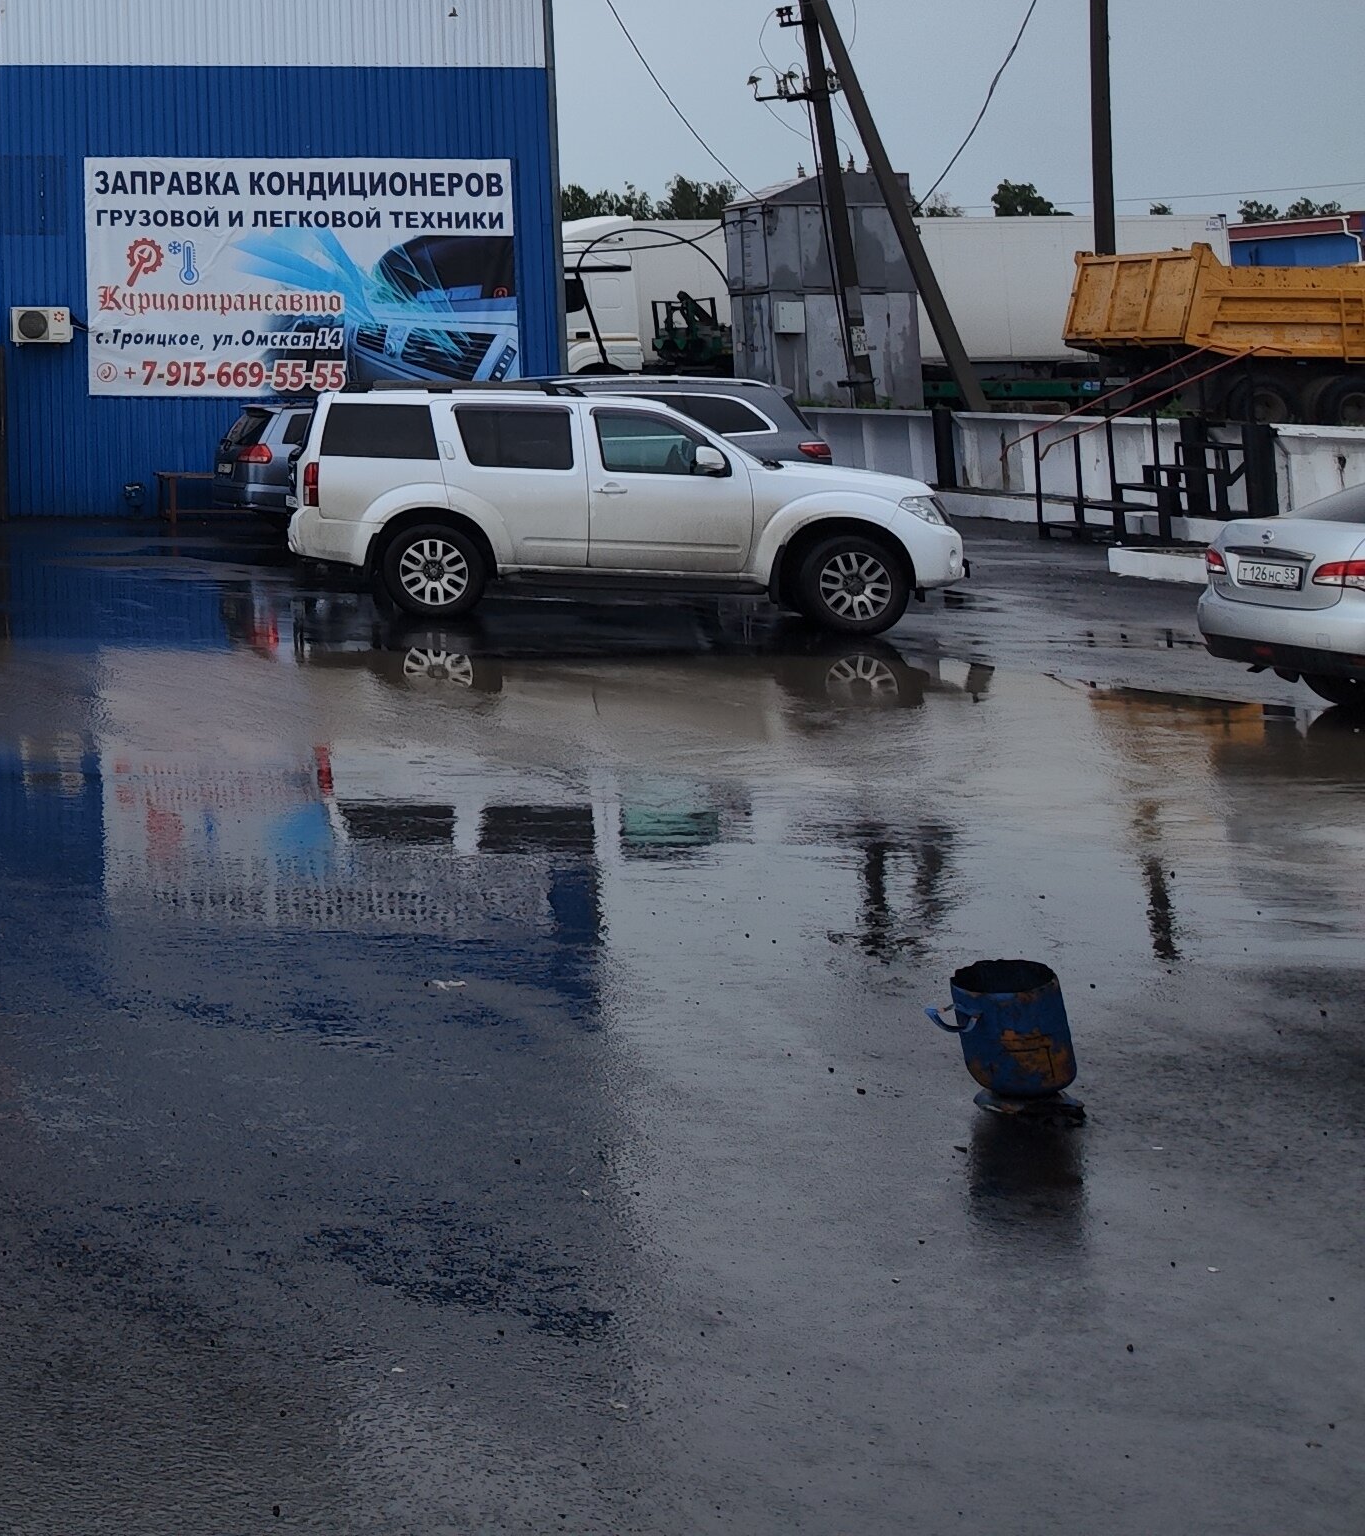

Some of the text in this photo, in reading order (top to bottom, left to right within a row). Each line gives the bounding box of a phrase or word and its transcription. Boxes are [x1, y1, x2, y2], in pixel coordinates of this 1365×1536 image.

[95, 170, 504, 201] ЗАПРАВКА КОНДИЦИОНЕРОВ
[96, 206, 505, 229] ГРУЗОВОЙ И ЛЕГКОВОЙ ТЕХНИКИ
[98, 285, 342, 316] Курилотрансавто
[95, 329, 341, 350] с.Троицкое, ул.Омская 14
